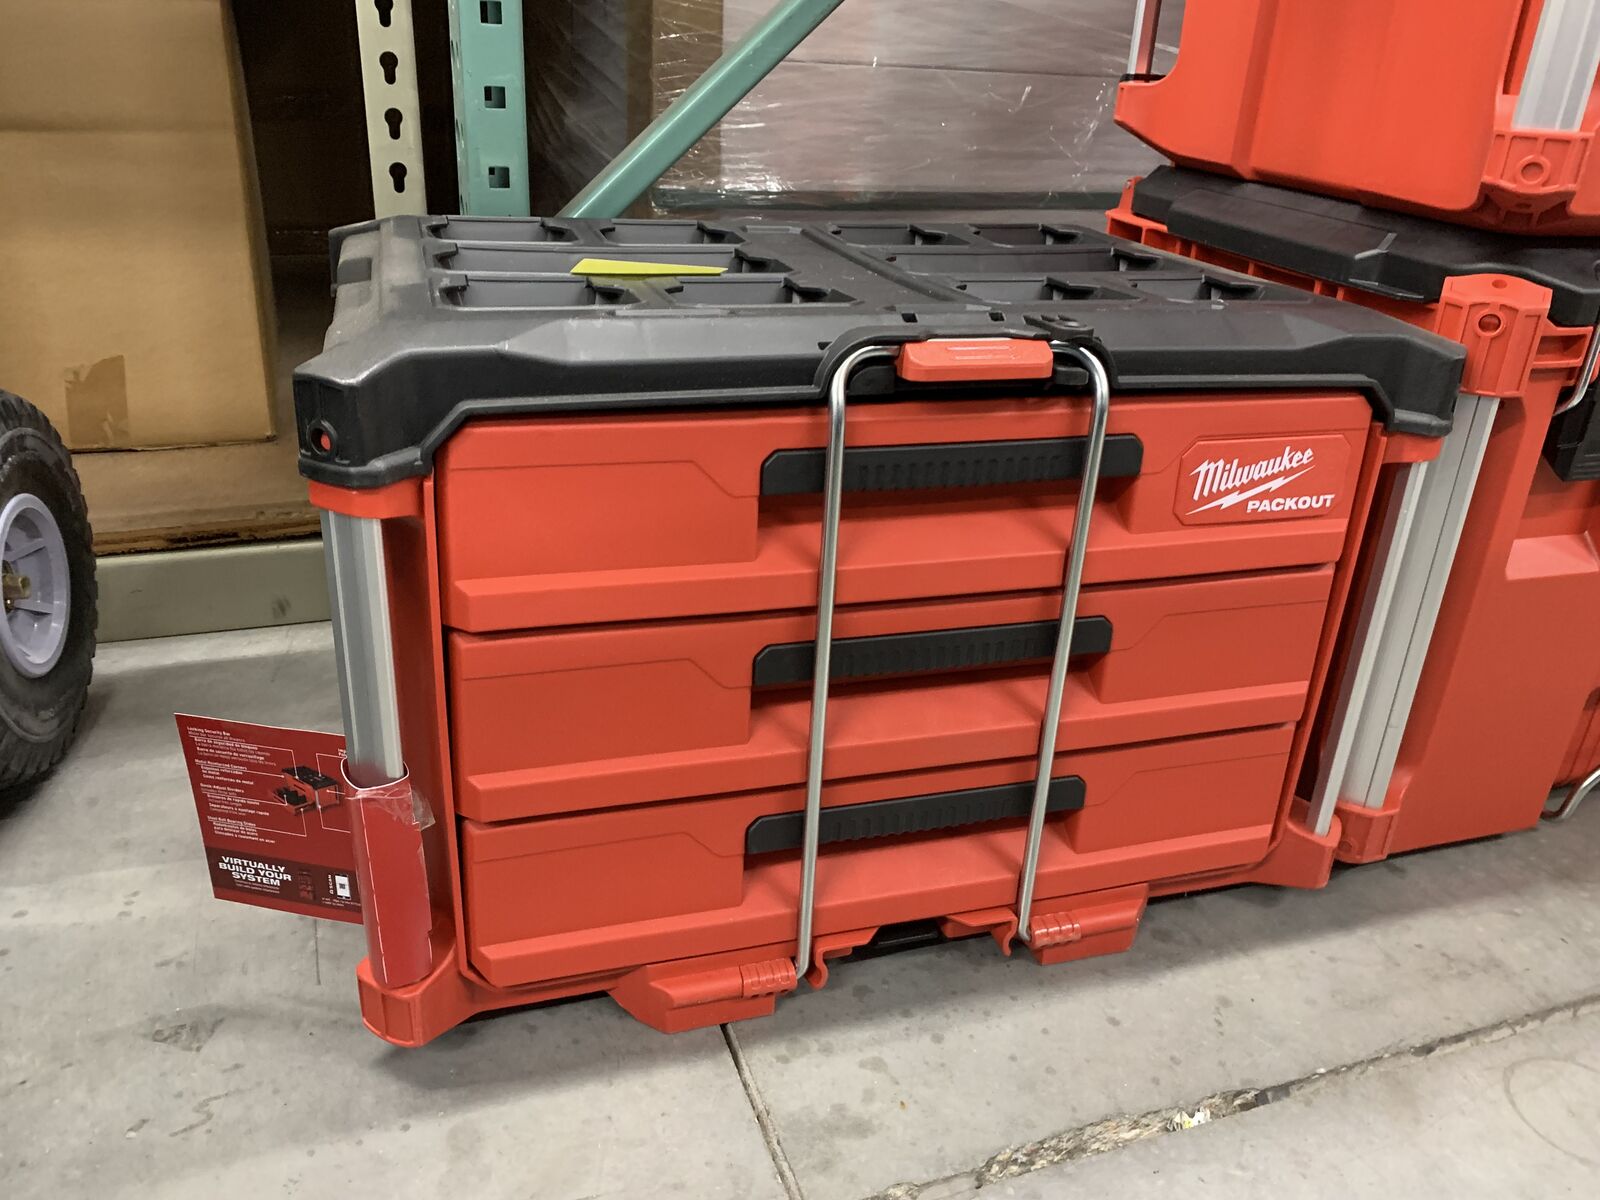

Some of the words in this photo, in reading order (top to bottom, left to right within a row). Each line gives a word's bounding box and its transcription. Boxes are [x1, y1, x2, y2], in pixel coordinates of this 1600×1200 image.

[1189, 445, 1314, 501] Milwaukee
[1246, 494, 1335, 513] PACKOUT
[218, 862, 255, 874] BUILD
[258, 868, 292, 881] YOUR
[222, 856, 286, 873] VIRTUALLY
[232, 871, 281, 886] SYSTEM
